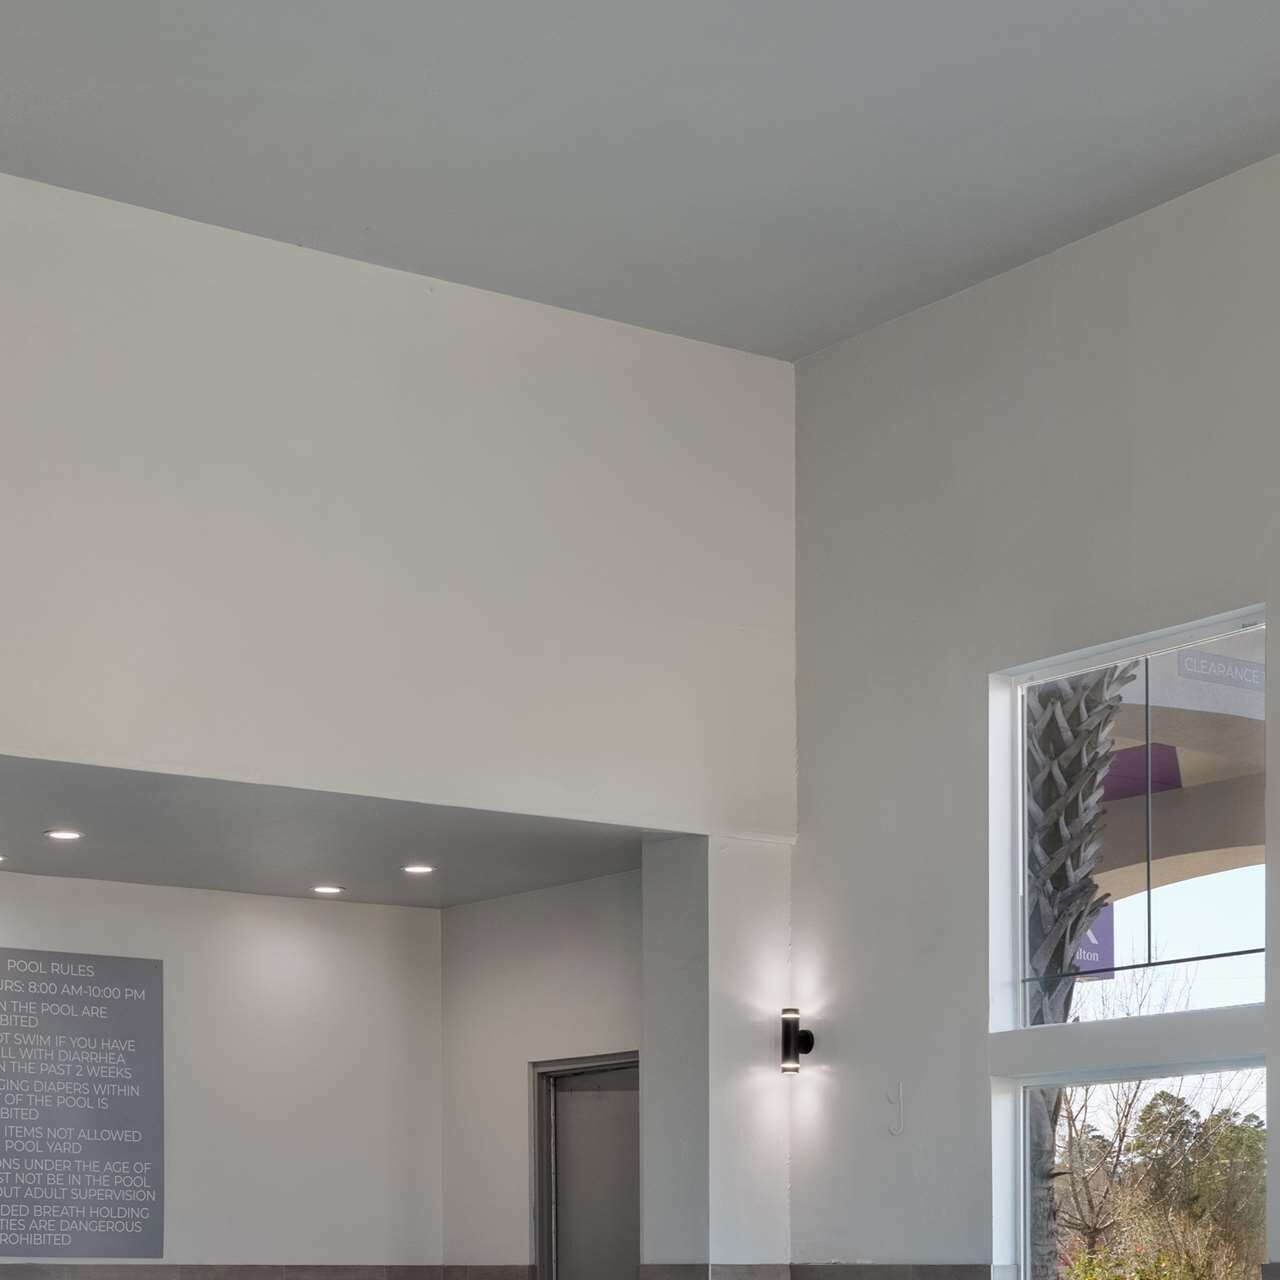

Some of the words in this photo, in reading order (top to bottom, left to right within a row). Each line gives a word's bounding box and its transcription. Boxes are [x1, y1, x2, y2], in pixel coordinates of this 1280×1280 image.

[1184, 656, 1260, 684] CLEARANCE
[6, 959, 47, 974] POOL
[50, 962, 95, 978] RULES
[28, 981, 57, 995] 8:00
[124, 988, 145, 1001] PM
[11, 1000, 36, 1014] THE
[40, 1002, 78, 1017] POOL
[81, 1005, 107, 1019] ARE
[13, 1033, 51, 1047] SWIM
[54, 1035, 66, 1048] IF
[68, 1036, 97, 1049] YOU
[101, 1038, 135, 1052] HAVE
[18, 1047, 54, 1061] WITH
[58, 1049, 126, 1065] DIARRHEA
[9, 1061, 35, 1074] THE
[39, 1062, 73, 1076] PAST
[75, 1064, 83, 1077] 2
[86, 1065, 132, 1079] WEEKS
[33, 1080, 89, 1094] DIAPERS
[92, 1083, 140, 1097] WITHIN
[4, 1092, 23, 1106] OF
[26, 1093, 52, 1107] THE
[56, 1095, 94, 1109] POOL
[97, 1097, 108, 1109] IS
[3, 1125, 43, 1139] ITEMS
[46, 1127, 74, 1140] NOT
[76, 1128, 142, 1142] ALLOWED
[4, 1139, 43, 1153] POOL
[45, 1141, 82, 1154] YARD
[23, 1158, 72, 1171] UNDER
[74, 1159, 100, 1172] THE
[102, 1160, 130, 1173] AGE
[132, 1161, 152, 1174] OF
[14, 1172, 43, 1185] NOT
[46, 1173, 64, 1185] BE
[68, 1174, 81, 1186] IN
[84, 1174, 110, 1187] THE
[114, 1175, 151, 1188] POOL
[23, 1187, 68, 1199] ADULT
[71, 1188, 156, 1201] SUPERVISION
[32, 1205, 85, 1218] BREATH
[89, 1206, 150, 1219] HOLDING
[28, 1219, 56, 1231] ARE
[59, 1219, 142, 1233] DANGEROUS
